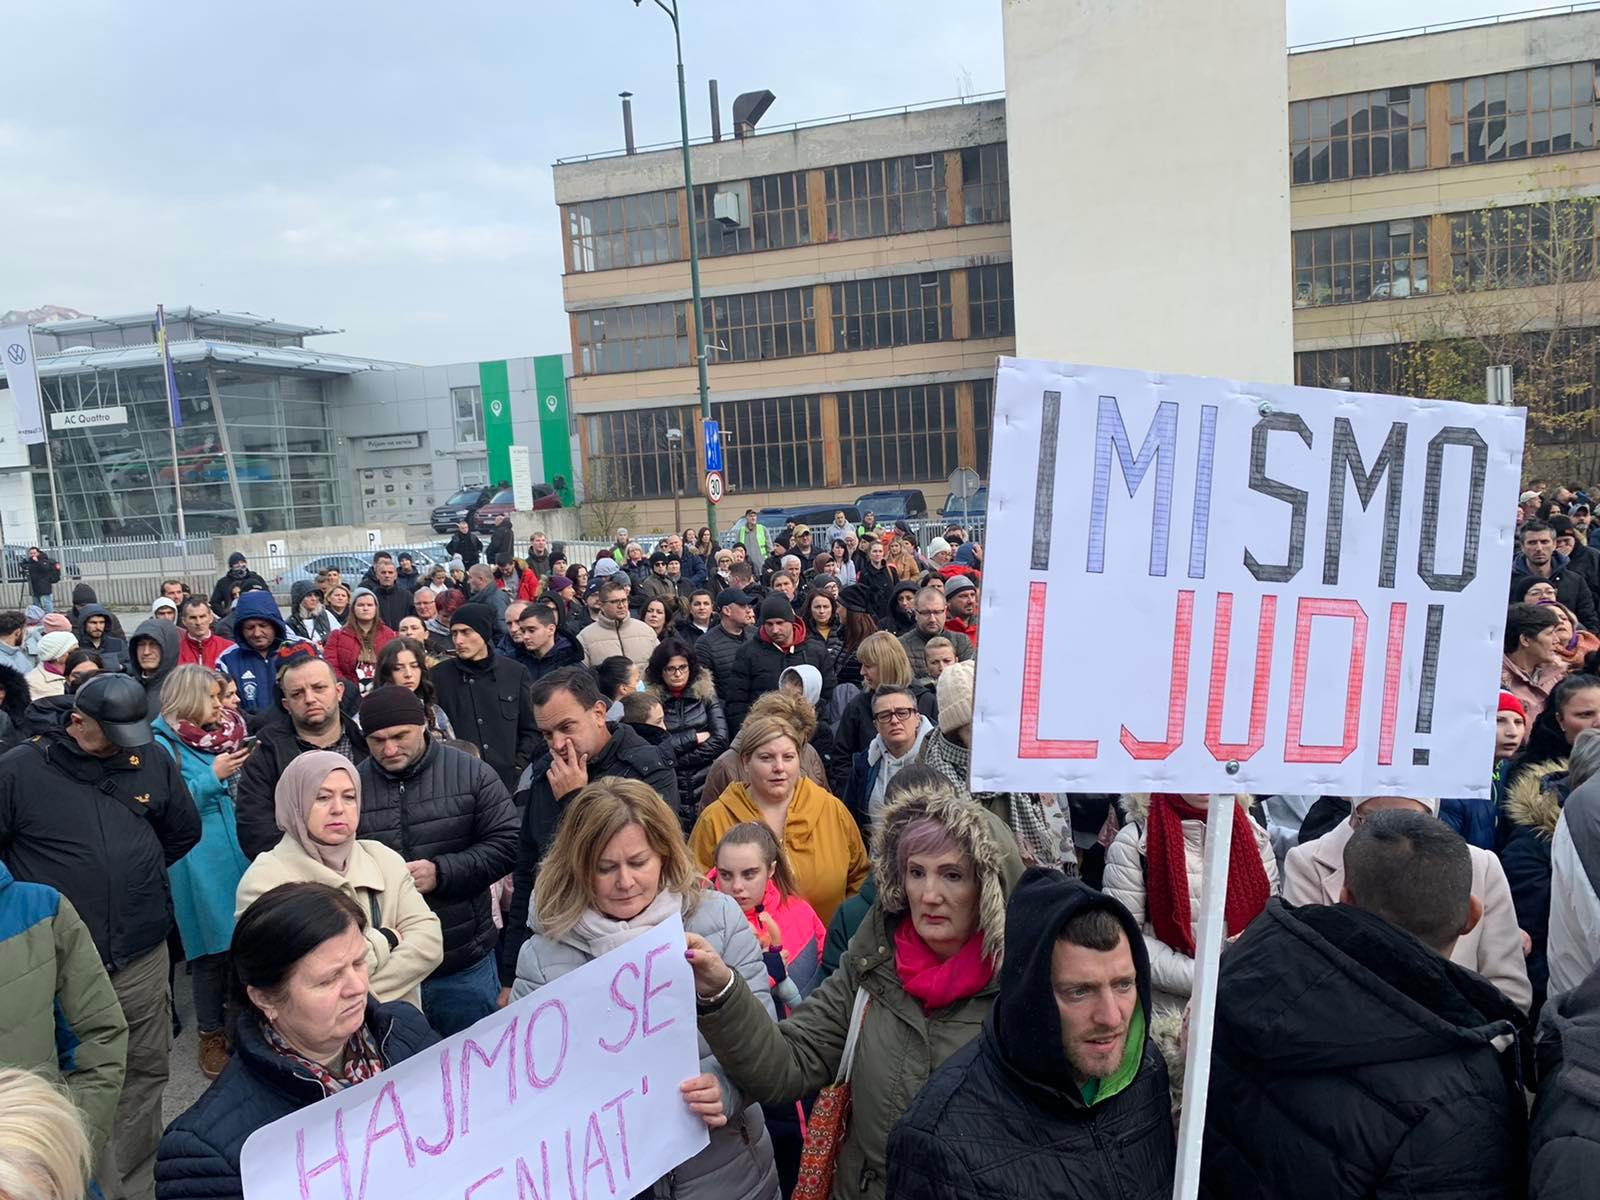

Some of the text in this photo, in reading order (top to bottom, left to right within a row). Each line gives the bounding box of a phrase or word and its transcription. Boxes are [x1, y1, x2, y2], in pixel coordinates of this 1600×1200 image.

[65, 414, 110, 424] AC Quattro
[711, 480, 719, 495] 30
[1030, 390, 1489, 593] I MI SMO
[368, 533, 375, 545] P
[270, 544, 277, 555] P
[1018, 581, 1445, 766] LJUDI!
[296, 942, 675, 1200] HAJMO SE
